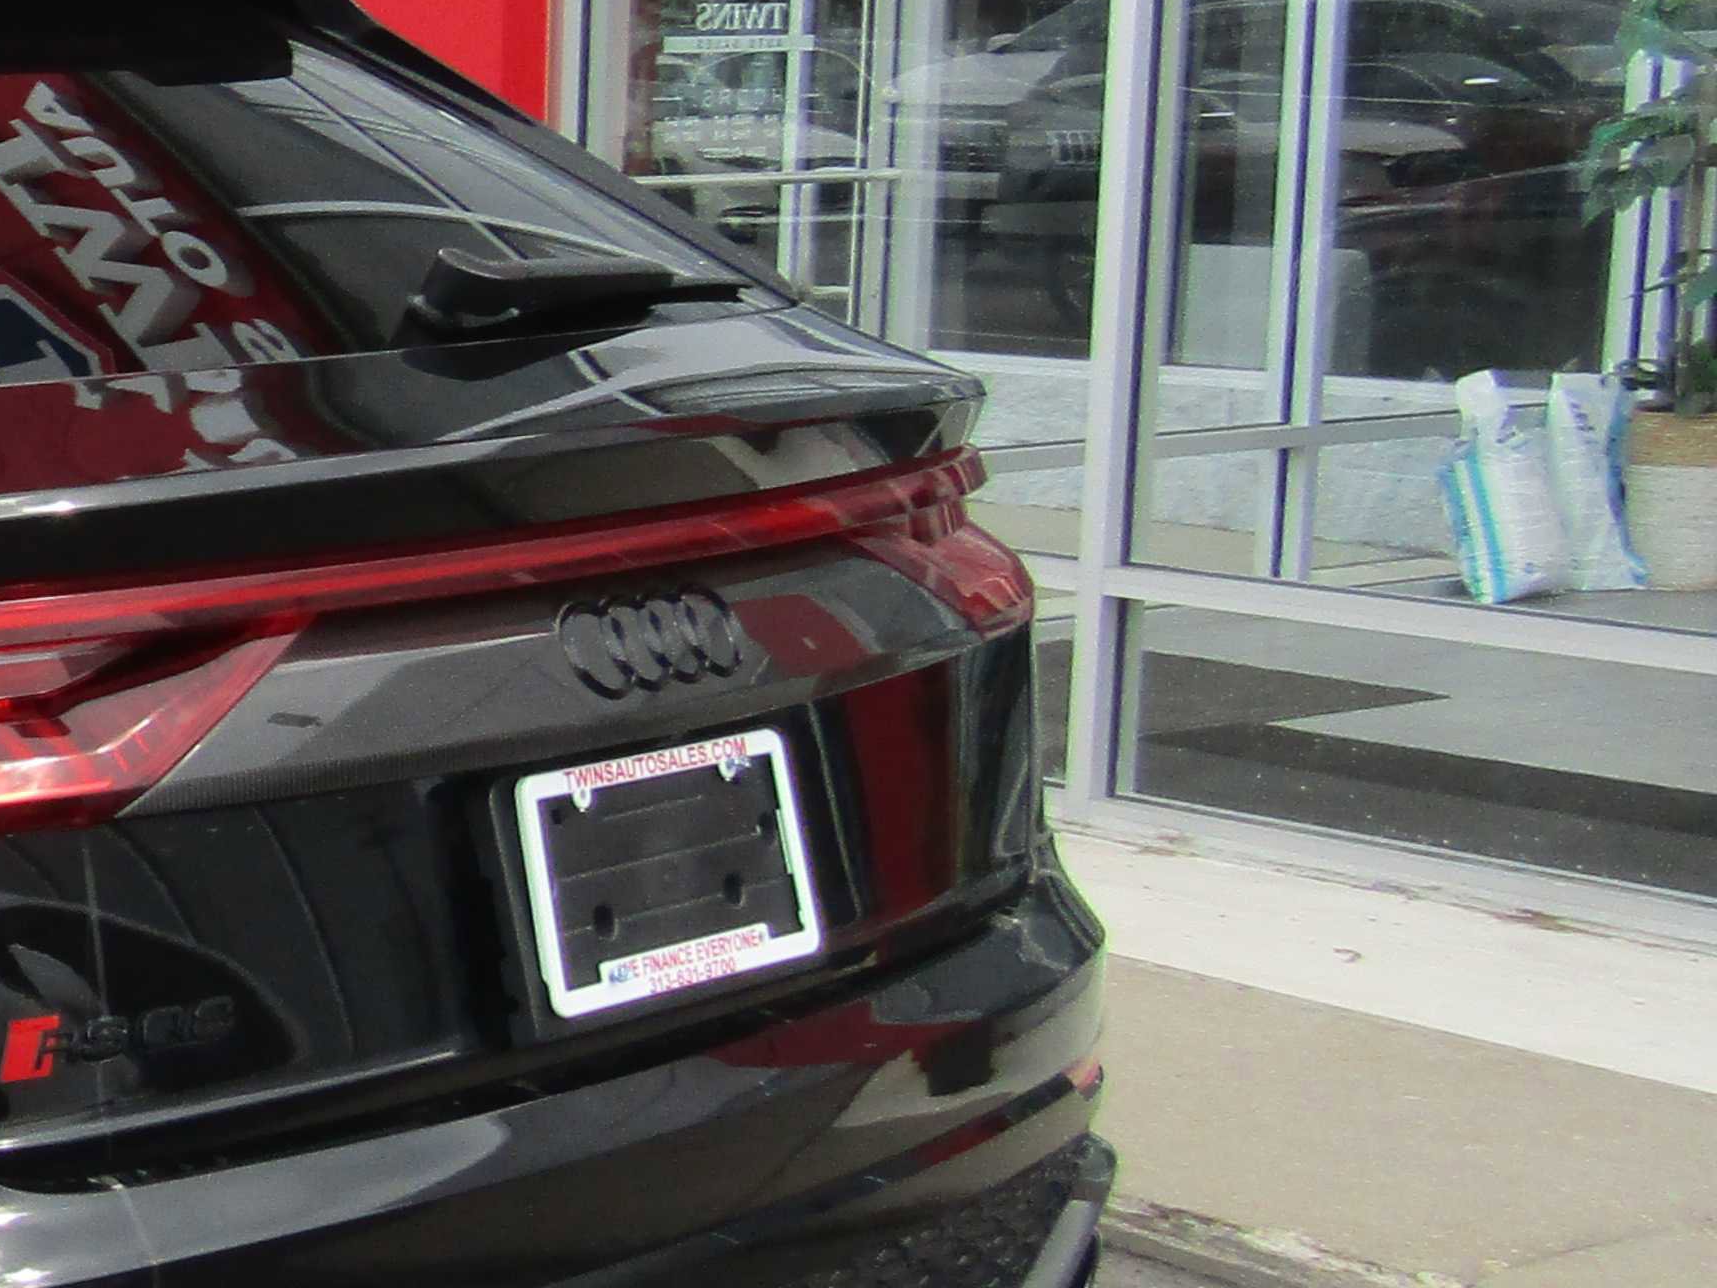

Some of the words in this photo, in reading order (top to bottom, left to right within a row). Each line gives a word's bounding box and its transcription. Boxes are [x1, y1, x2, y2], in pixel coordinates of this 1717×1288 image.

[564, 737, 747, 788] TWINSAUTOSALES.COM
[642, 944, 693, 975] FINANCE
[696, 928, 759, 962] EVERYONE
